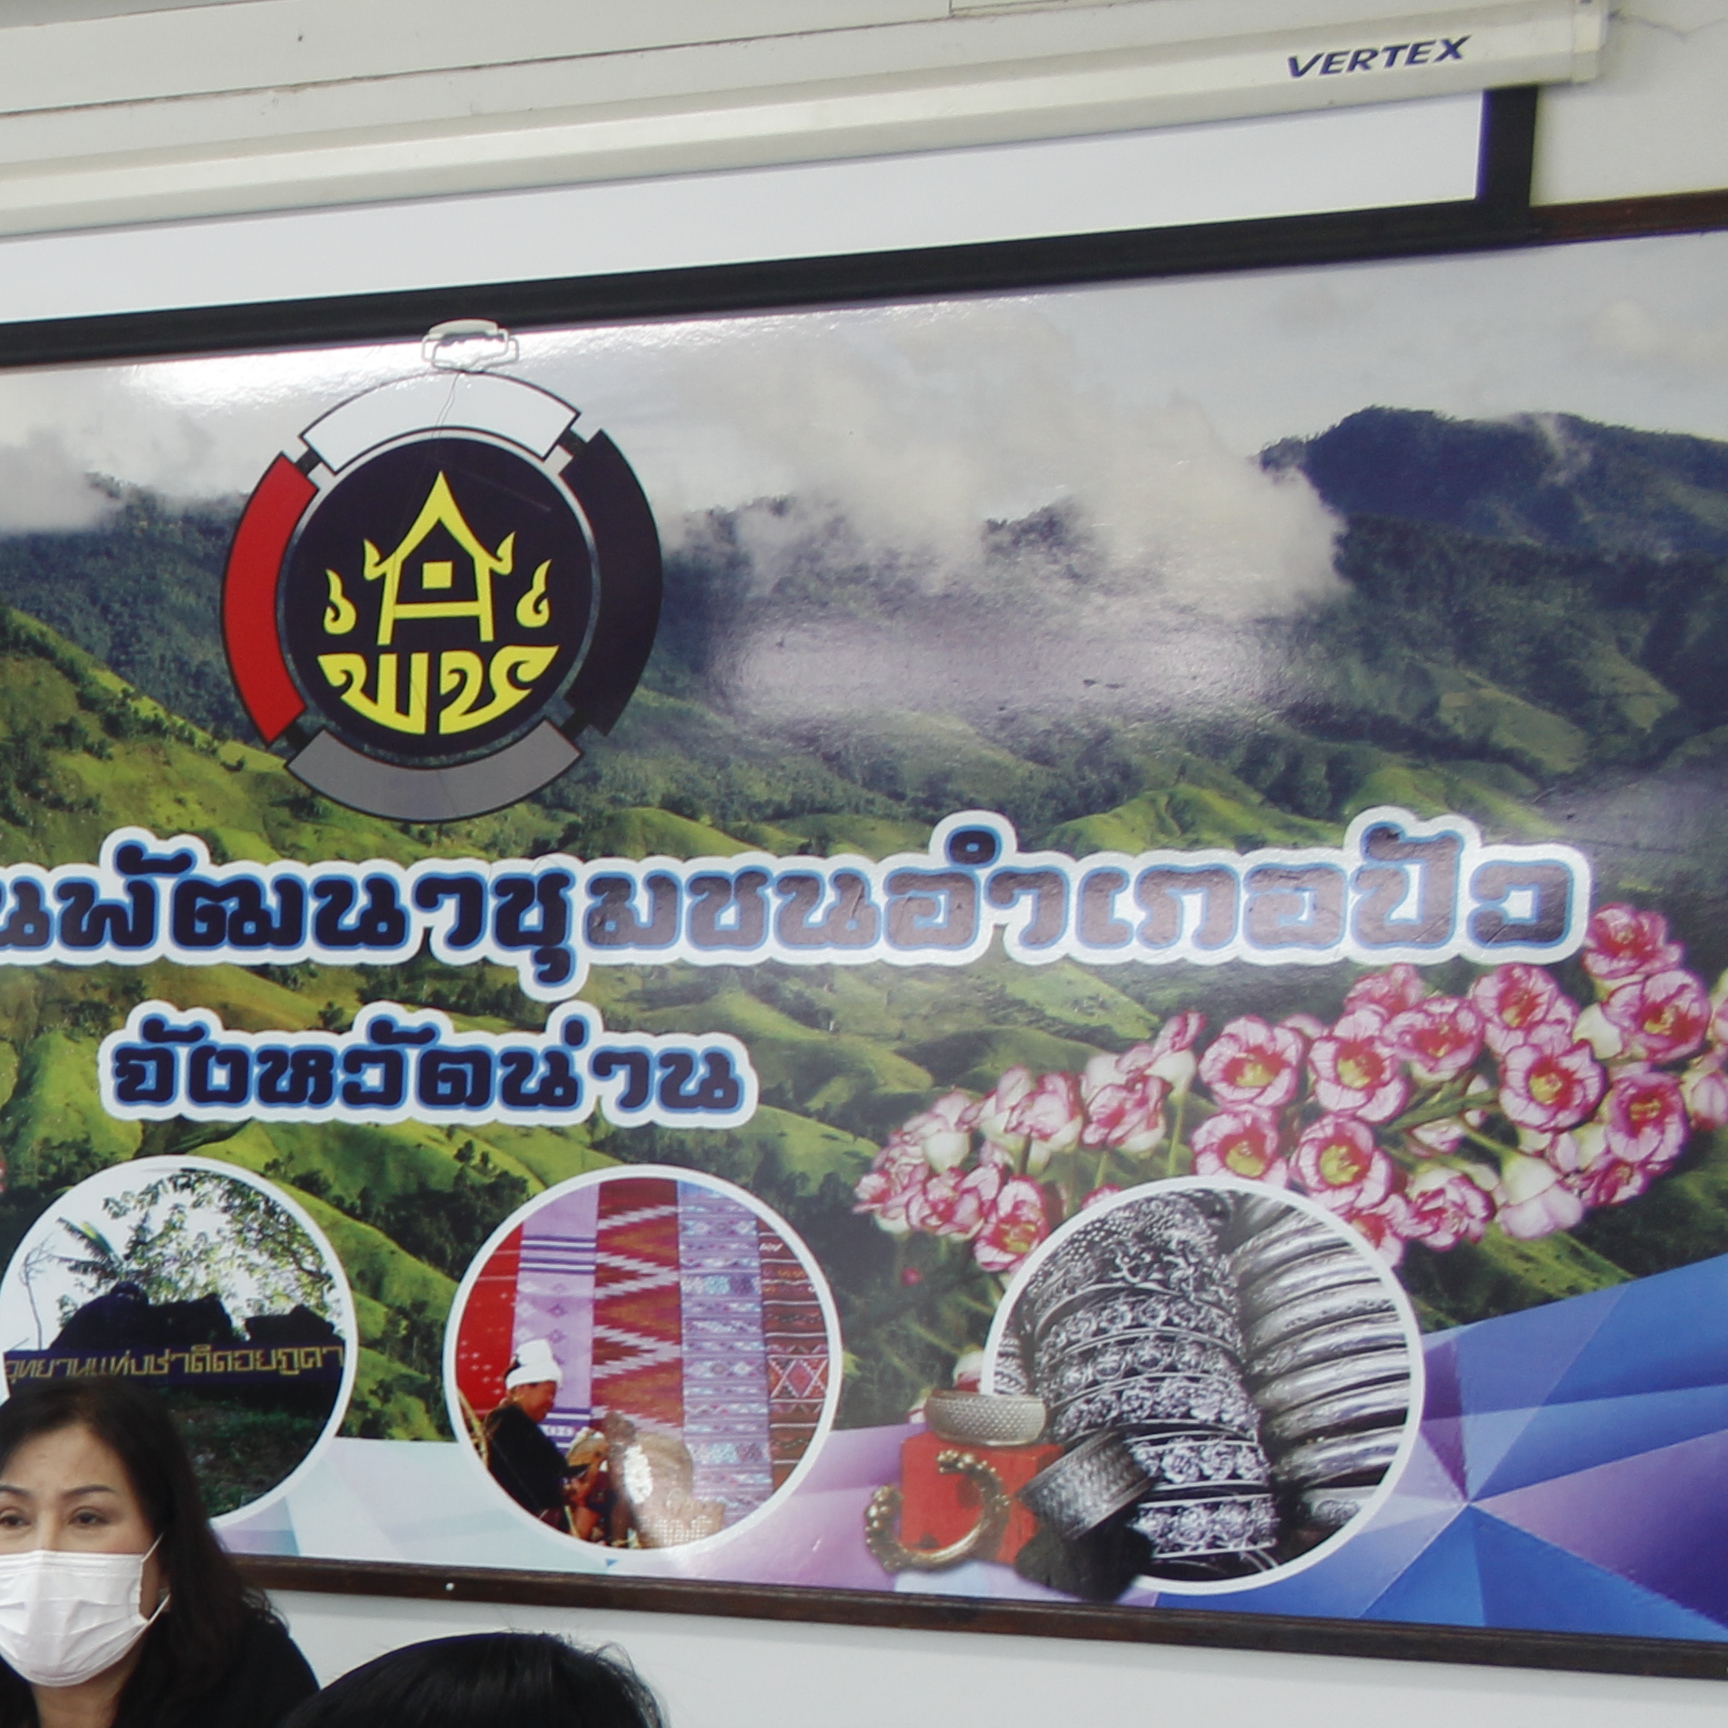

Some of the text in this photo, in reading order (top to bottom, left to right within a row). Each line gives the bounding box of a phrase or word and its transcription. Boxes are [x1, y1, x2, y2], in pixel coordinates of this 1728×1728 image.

[1287, 35, 1472, 79] VERTEX
[110, 1012, 747, 1112] จังหวัดน่าน
